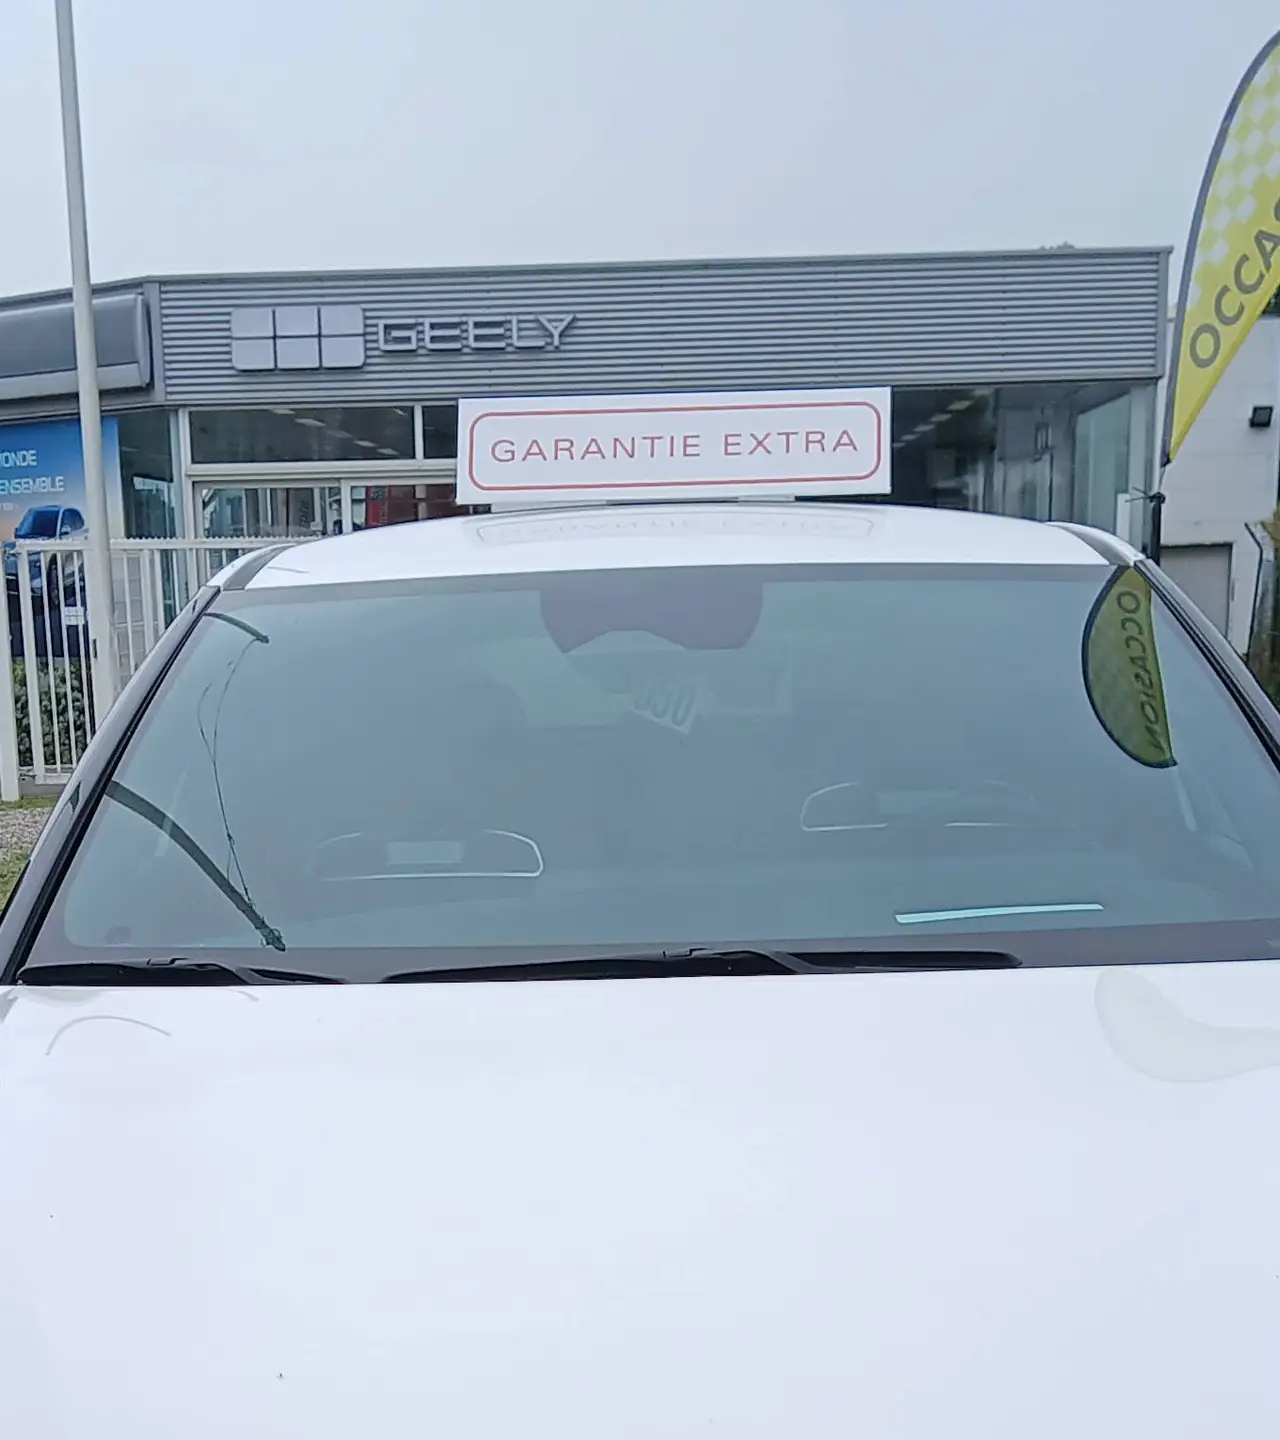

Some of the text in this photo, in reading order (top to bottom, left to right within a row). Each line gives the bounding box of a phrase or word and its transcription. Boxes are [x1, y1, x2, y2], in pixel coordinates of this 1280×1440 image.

[378, 314, 576, 351] GEELY
[490, 429, 858, 463] GARANTIE EXTRA
